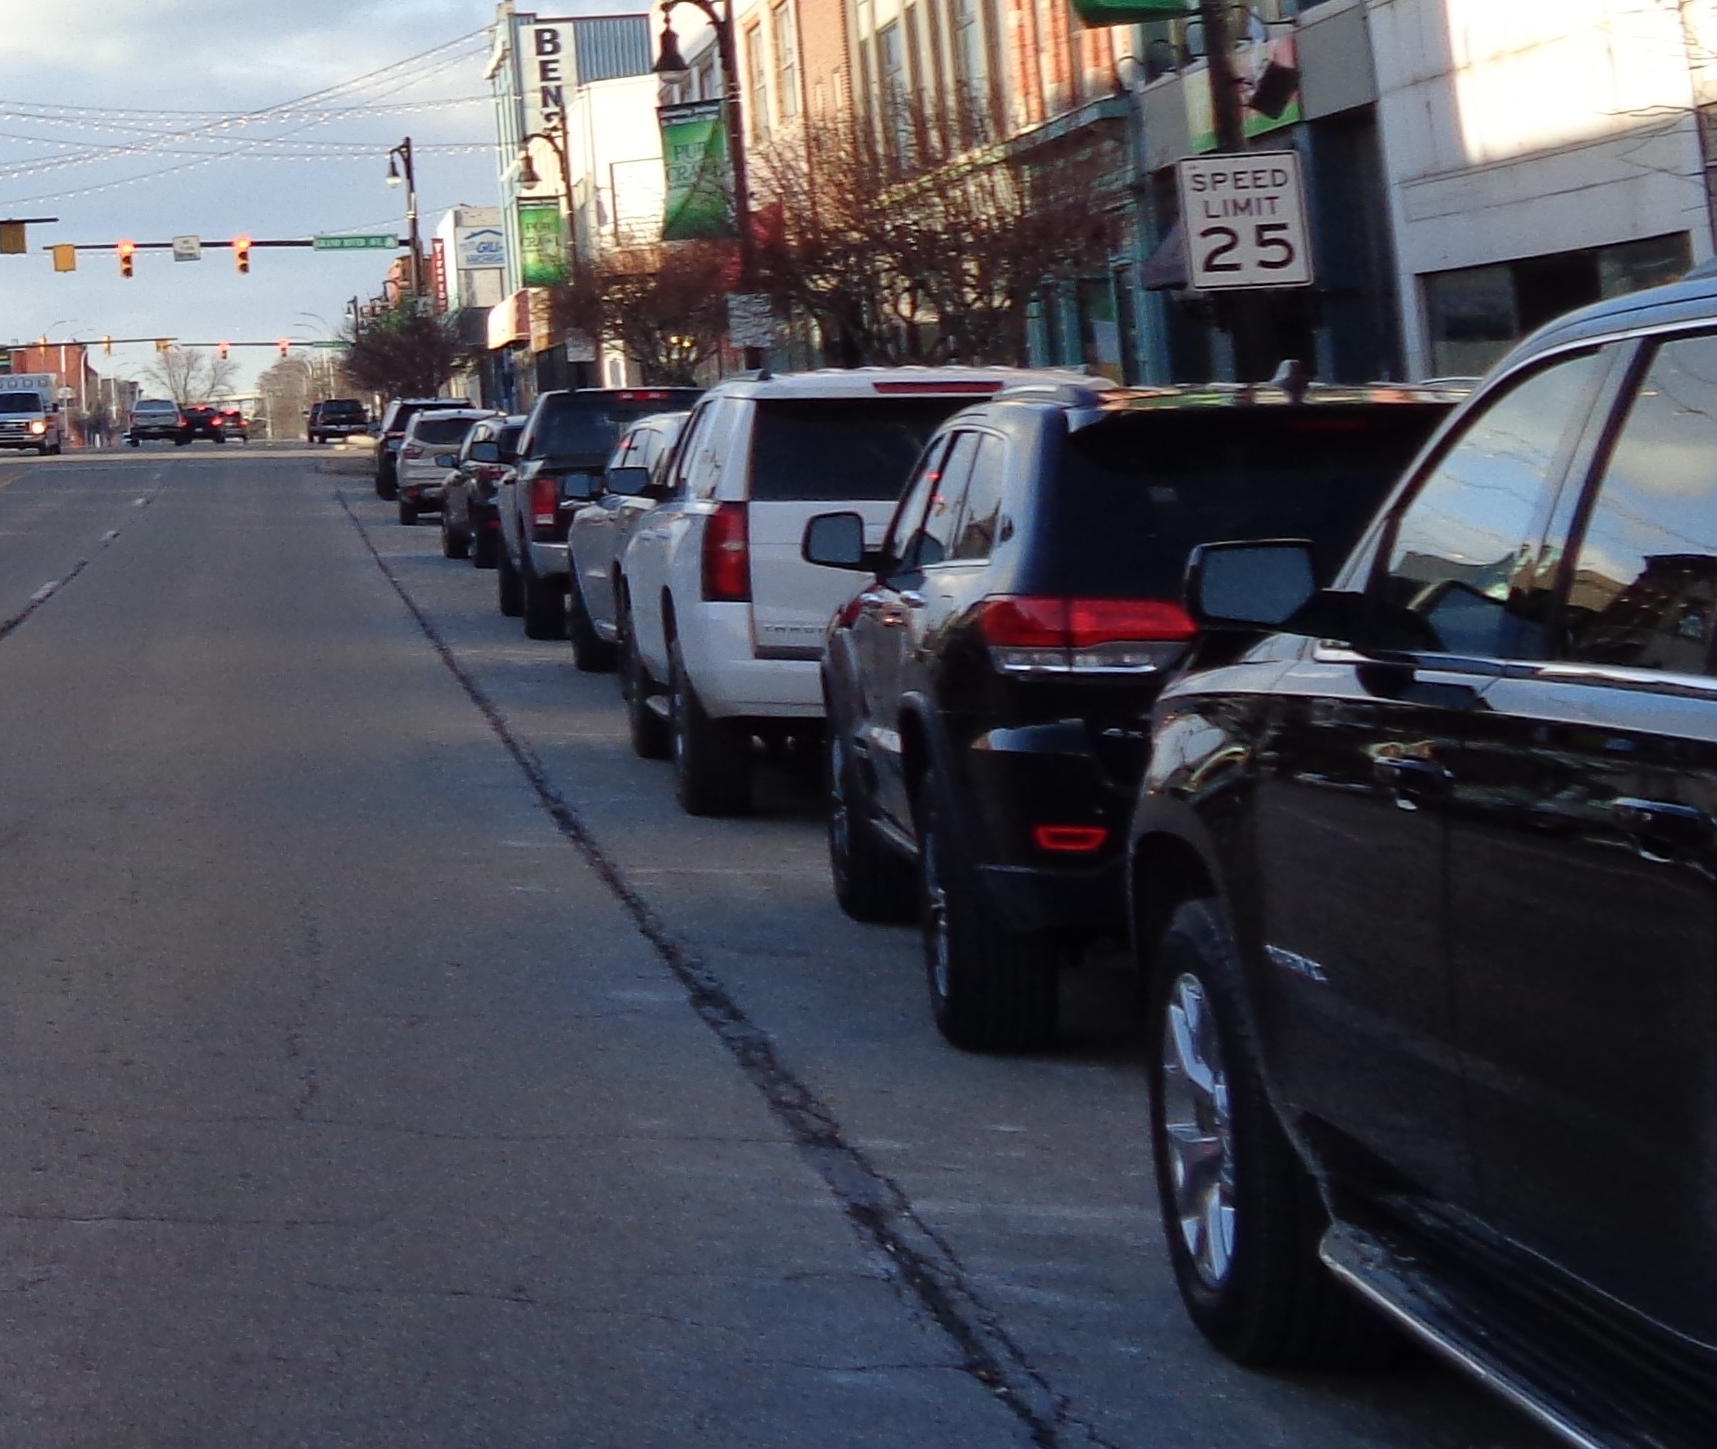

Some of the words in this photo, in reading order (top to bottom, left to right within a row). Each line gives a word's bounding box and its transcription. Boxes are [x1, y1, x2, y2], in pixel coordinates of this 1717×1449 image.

[1191, 169, 1288, 192] SPEED
[1203, 196, 1280, 219] LIMIT
[1199, 223, 1295, 272] 25
